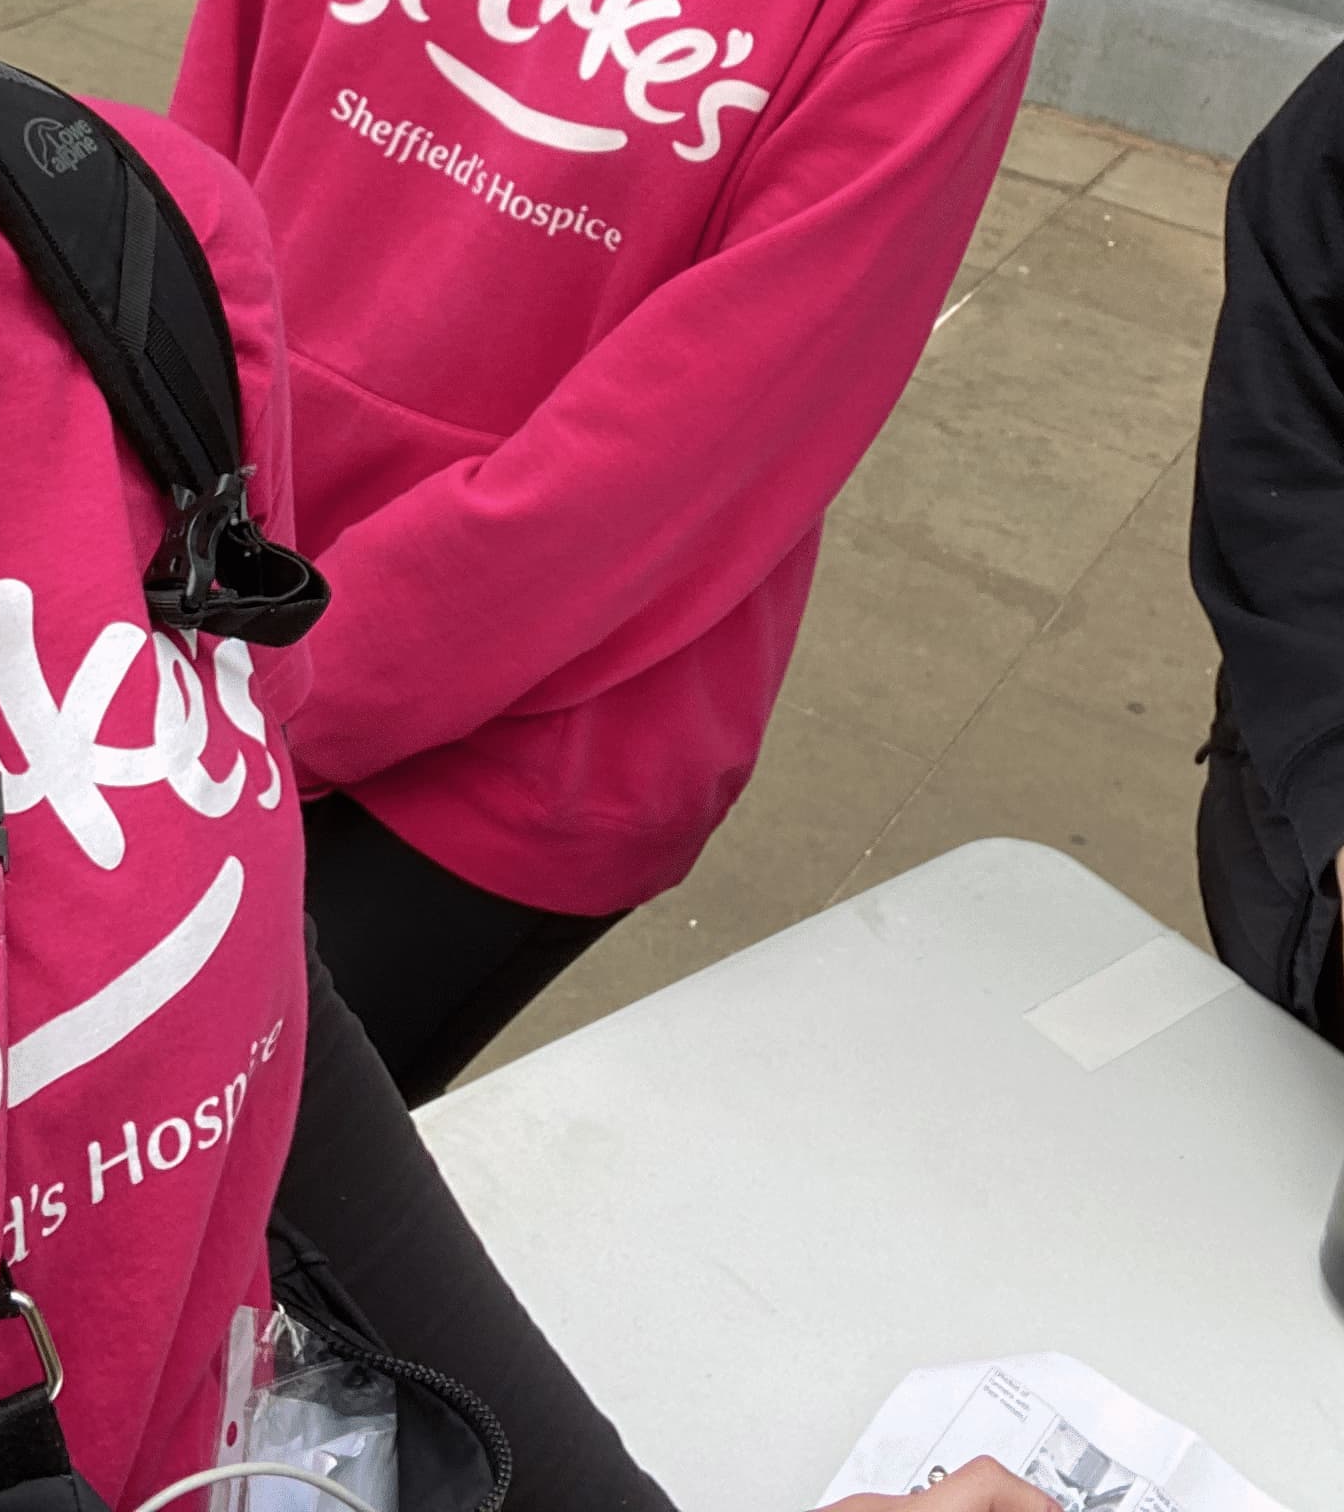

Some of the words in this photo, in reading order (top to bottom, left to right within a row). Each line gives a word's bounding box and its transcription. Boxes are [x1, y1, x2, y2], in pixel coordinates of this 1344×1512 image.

[54, 115, 94, 150] Lowe
[50, 134, 100, 176] alpine
[330, 88, 488, 195] Sheffield's
[485, 173, 623, 253] Hospice
